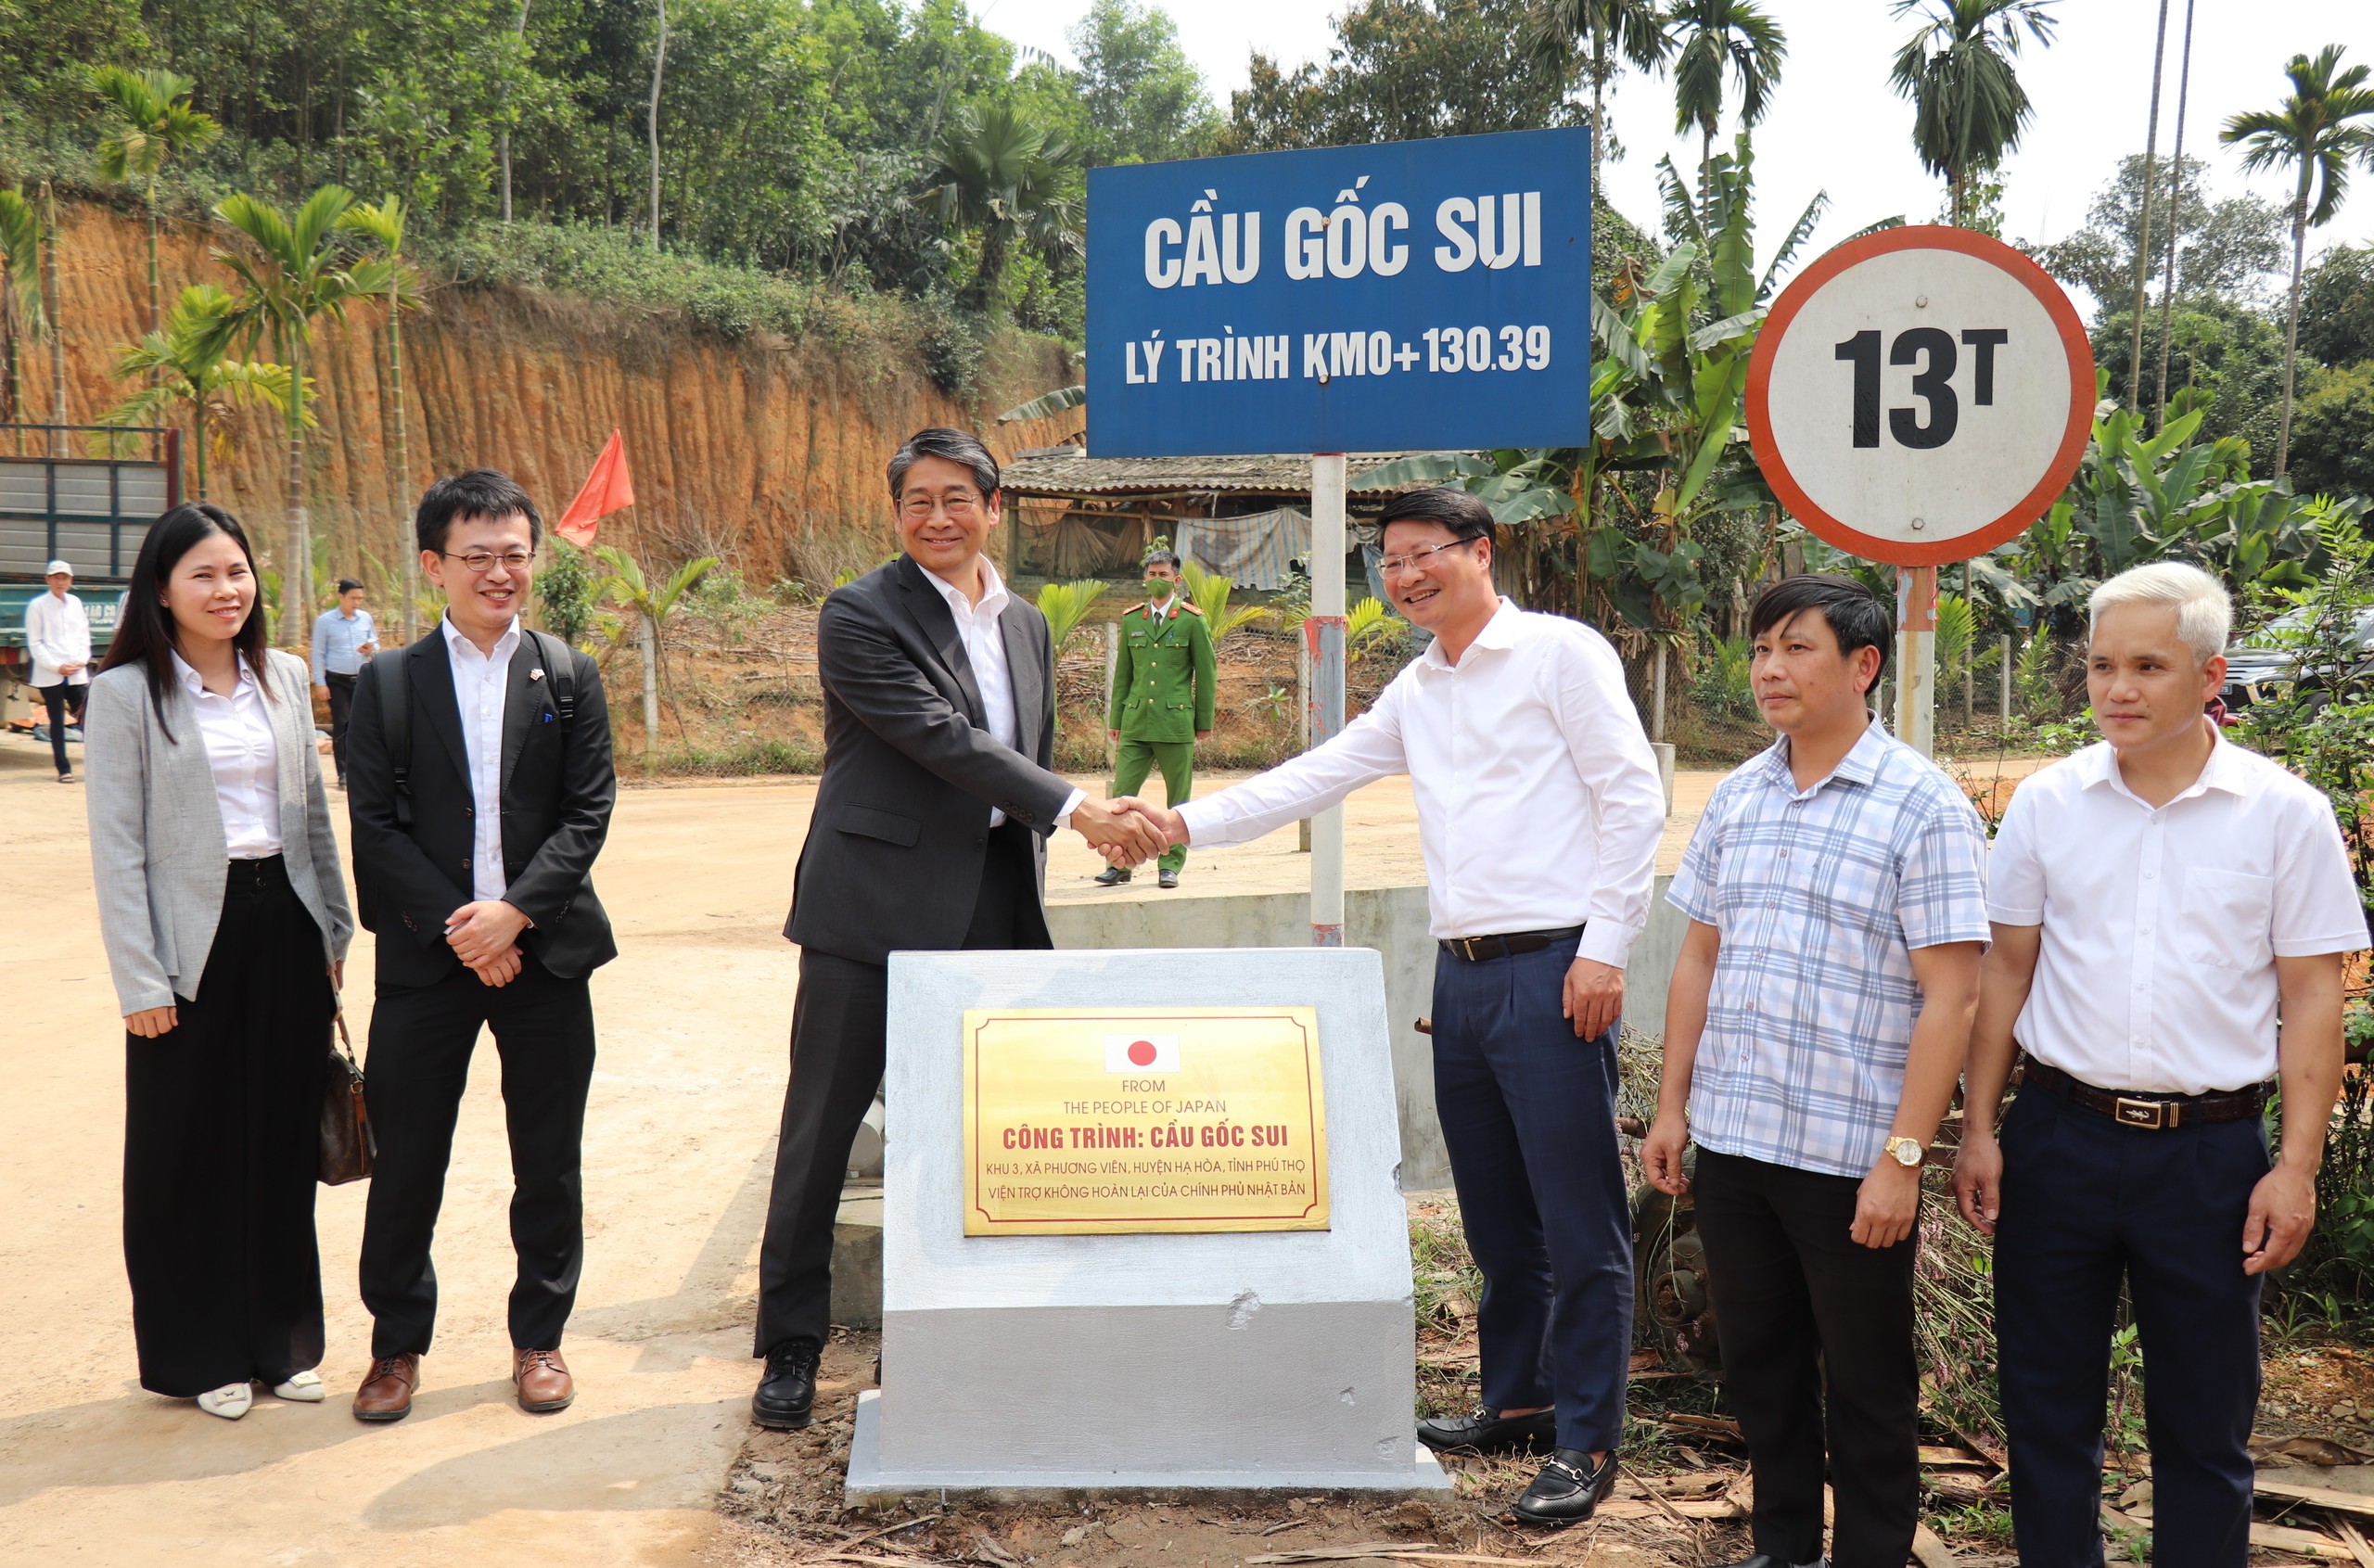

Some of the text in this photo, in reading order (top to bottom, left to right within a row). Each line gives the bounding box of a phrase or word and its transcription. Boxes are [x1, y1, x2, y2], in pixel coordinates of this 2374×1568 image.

[1144, 174, 1542, 289] CẦU GỐC SUI
[1125, 329, 1165, 385] LÝ
[1176, 325, 1290, 383] TRÌNH
[1122, 1079, 1166, 1092] FROM
[1064, 1100, 1226, 1115] THE PEOPLE OF JAPAN
[1002, 1117, 1288, 1150] CÔNG TRÌNH: CẦU GỐC SUI
[986, 1157, 1306, 1176] KHU 3, XÃ PHƯƠNG VIÊN, HUYỆN HẠ HÒA, TỈNH PHÚ THỌ
[988, 1179, 1306, 1202] VIỆN TRỢ KHÔNG HOÀN LẠI CỦA CHÍNH PHỦ NHẬT BẢN
